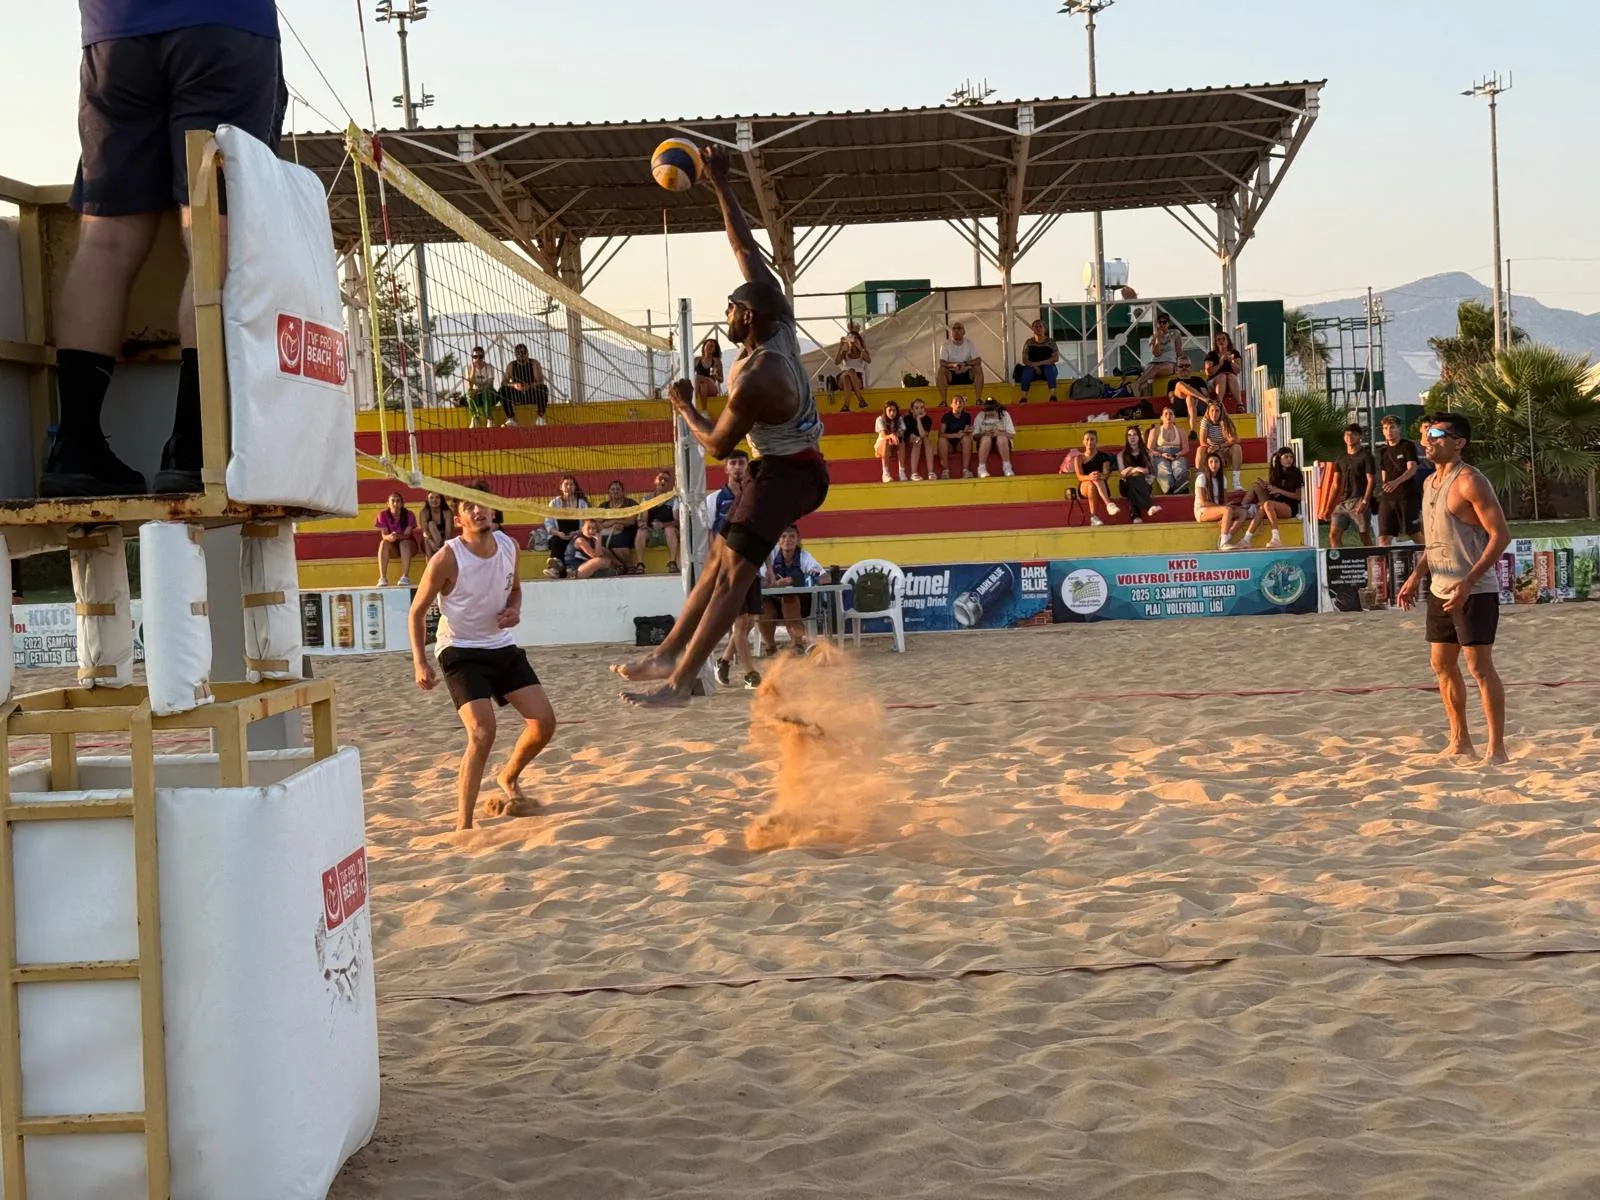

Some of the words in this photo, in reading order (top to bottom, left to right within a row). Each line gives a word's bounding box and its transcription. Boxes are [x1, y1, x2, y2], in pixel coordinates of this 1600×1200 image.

[307, 331, 319, 346] TVF
[320, 334, 332, 350] PRO
[306, 346, 332, 366] BEACH
[336, 340, 344, 358] 20
[336, 360, 346, 381] 18
[1021, 566, 1048, 578] DARK
[1168, 560, 1198, 570] KKTC
[977, 580, 992, 595] DARK
[989, 567, 1005, 582] BLUE
[1022, 578, 1048, 591] BLUE
[1117, 573, 1170, 585] VOLEYBOL
[1173, 569, 1250, 582] FEDERASYONU
[1132, 588, 1150, 601] 2025
[1202, 585, 1236, 598] MELEKLER
[901, 598, 926, 610] Energy
[927, 596, 948, 607] Drink
[1145, 604, 1160, 616] PLAJ
[1166, 601, 1204, 615] VOLEYBOLU
[14, 624, 28, 633] OL
[24, 637, 42, 650] 2023
[47, 634, 77, 651] ŞAMPİYO
[30, 649, 62, 665] ÇETİNTAŞ
